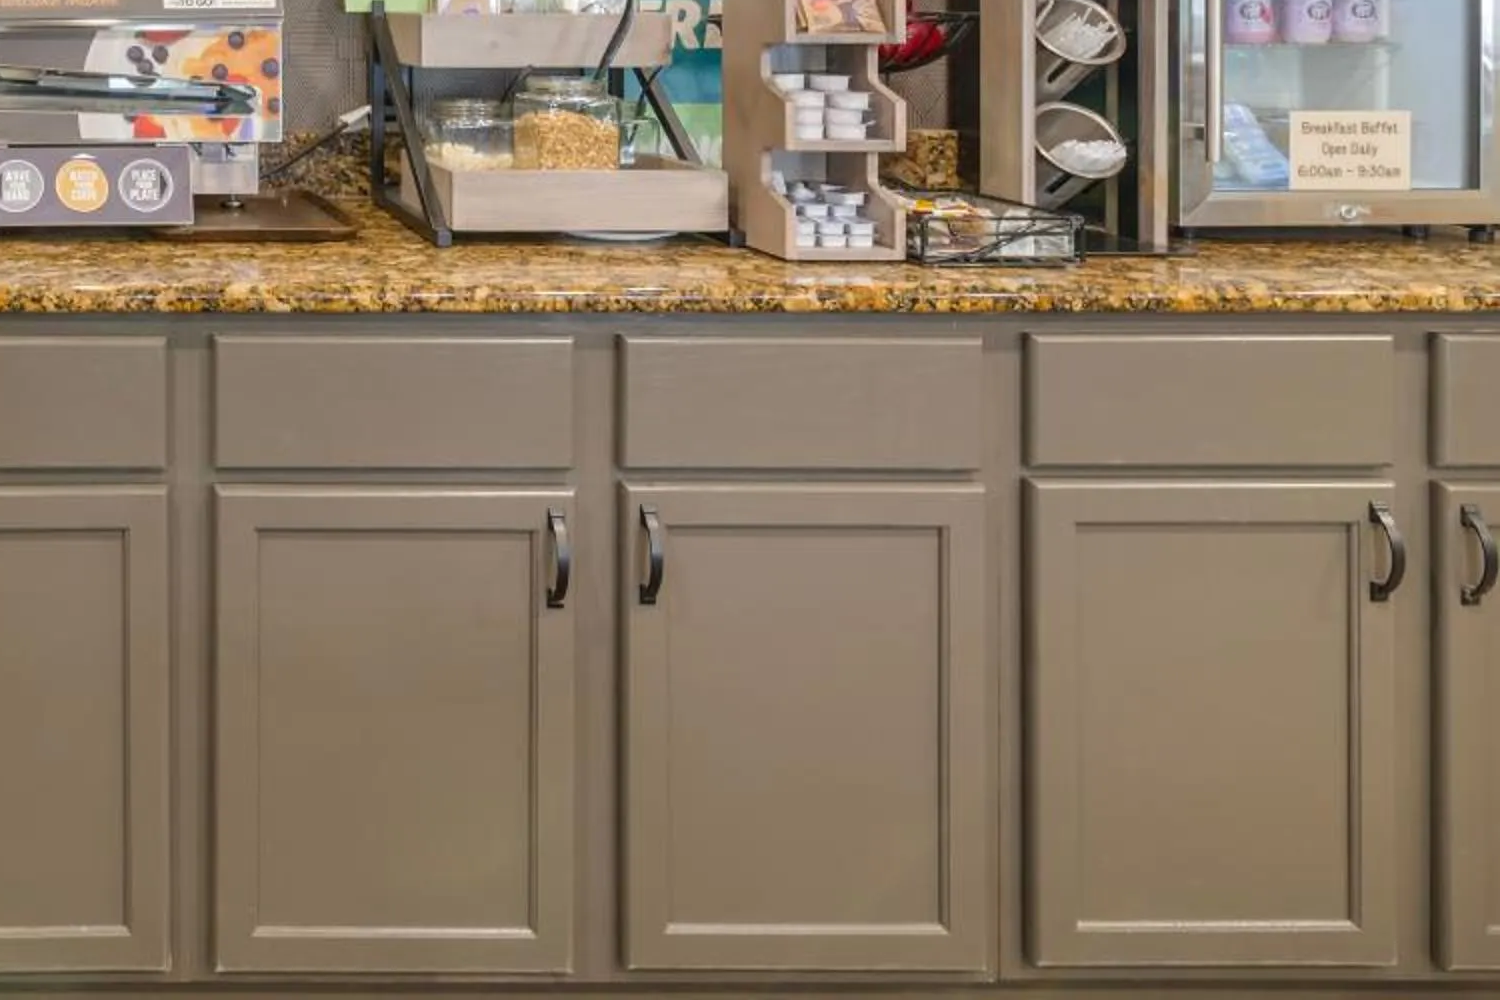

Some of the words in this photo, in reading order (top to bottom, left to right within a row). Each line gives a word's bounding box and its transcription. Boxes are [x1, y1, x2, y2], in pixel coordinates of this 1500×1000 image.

[1301, 121, 1358, 135] Breakfast
[1361, 121, 1398, 135] Buffet
[1321, 142, 1348, 158] Open
[1350, 142, 1379, 157] Daily
